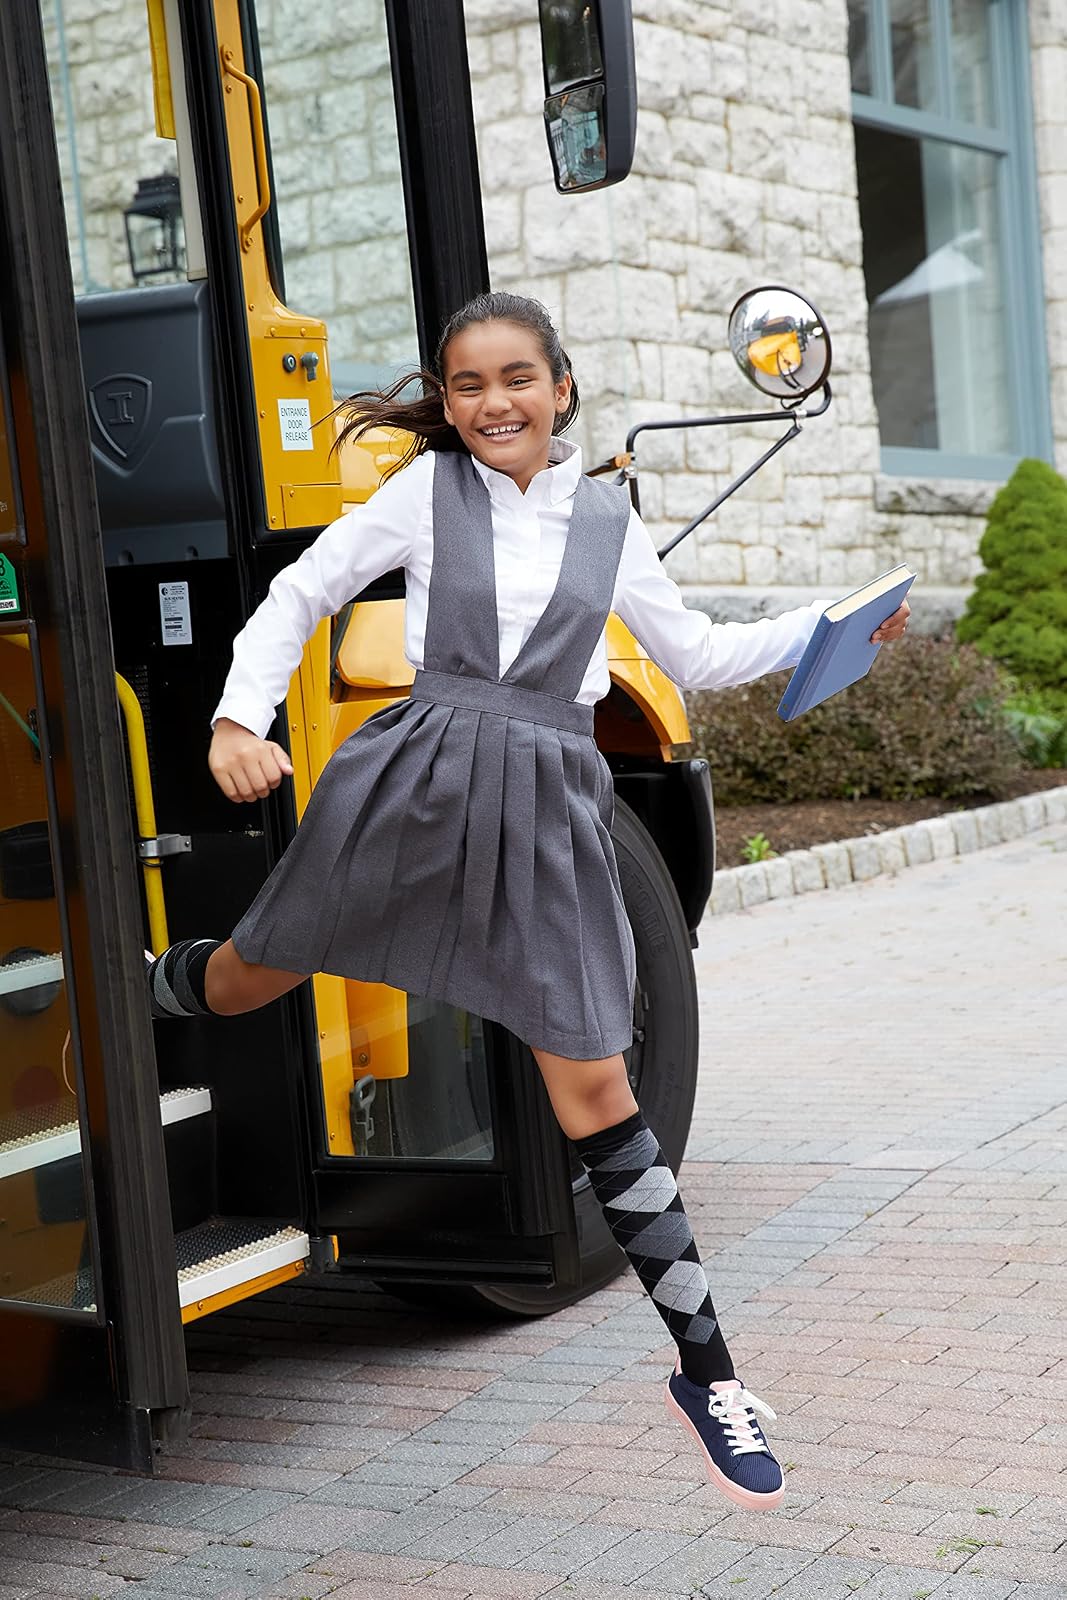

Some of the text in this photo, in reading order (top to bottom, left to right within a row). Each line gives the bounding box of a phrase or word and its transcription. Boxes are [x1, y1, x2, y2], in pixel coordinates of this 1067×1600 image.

[281, 408, 308, 417] ENTRANCE
[288, 420, 303, 429] DOOR
[286, 432, 308, 441] RELEASE
